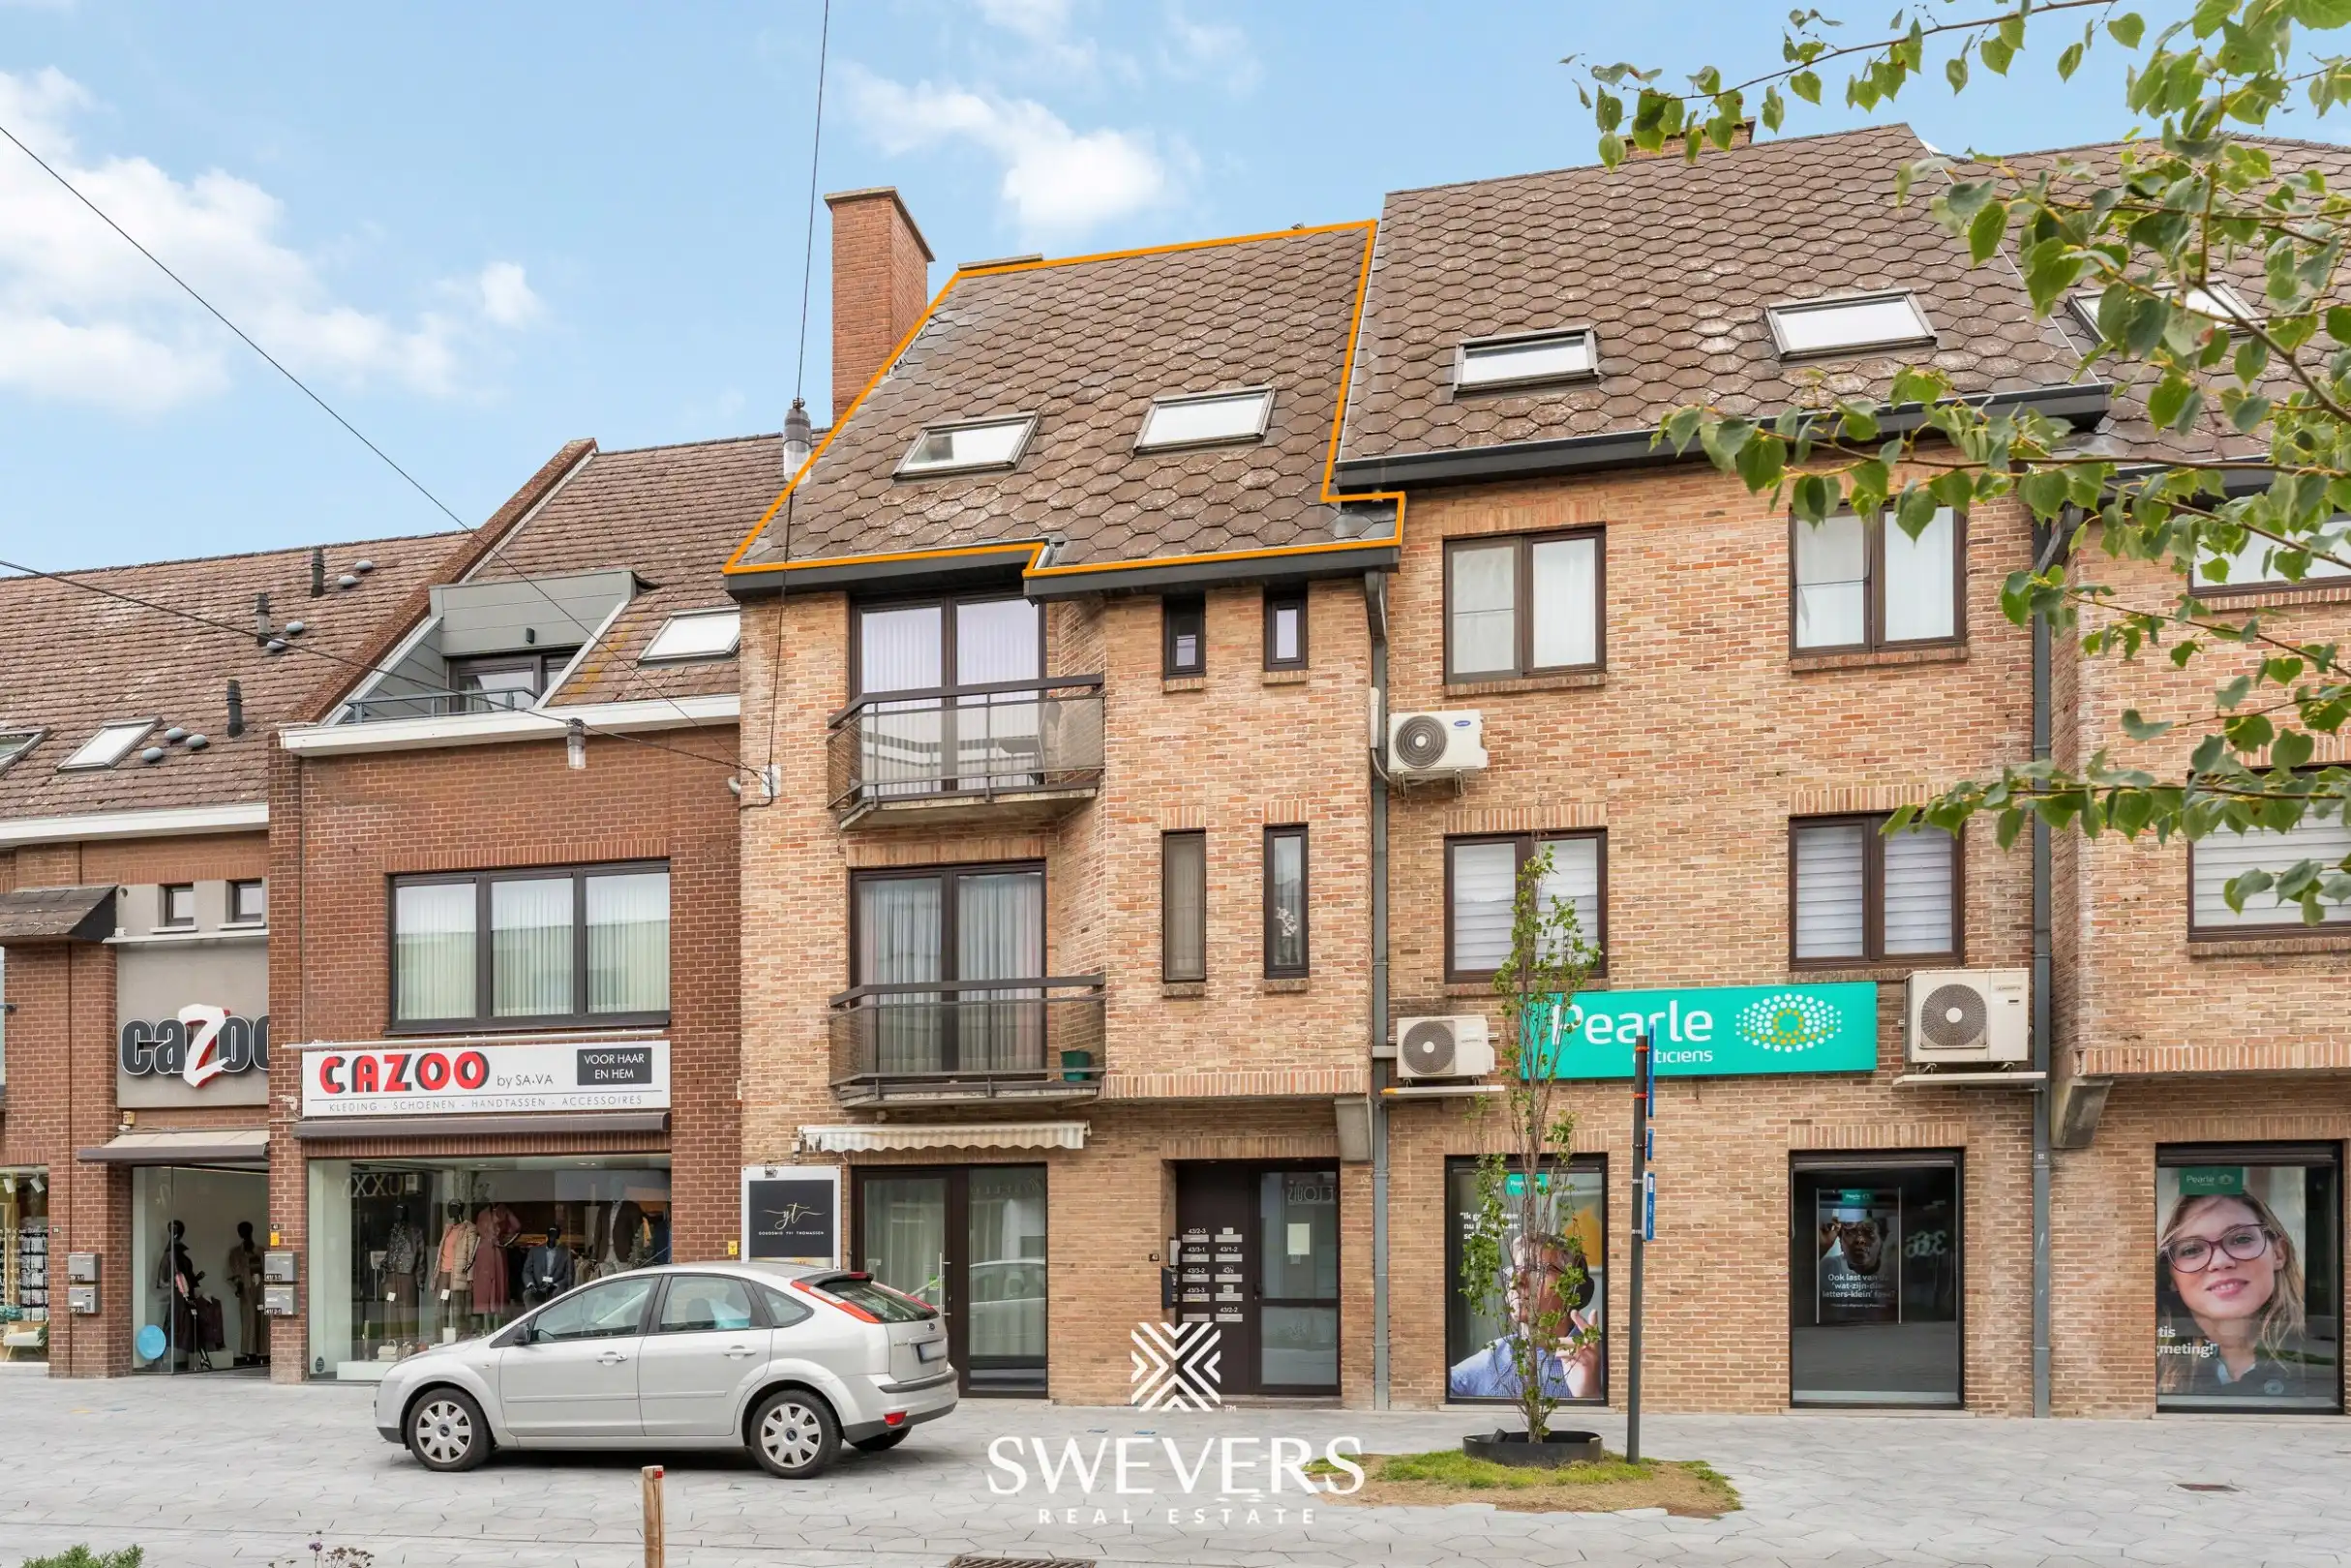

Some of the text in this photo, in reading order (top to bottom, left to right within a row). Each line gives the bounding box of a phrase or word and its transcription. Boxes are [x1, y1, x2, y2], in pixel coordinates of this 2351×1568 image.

[1552, 999, 1713, 1045] Pearle
[584, 1052, 645, 1066] VOOR HAAR
[319, 1051, 490, 1094] CAZOO
[497, 1074, 513, 1089] by
[594, 1069, 634, 1080] EN HEM
[329, 1096, 642, 1112] KLEDING SCHOENEN HANDTASSEN ACCESSOIRES
[1827, 1273, 1844, 1282] Ook
[1846, 1273, 1861, 1282] last
